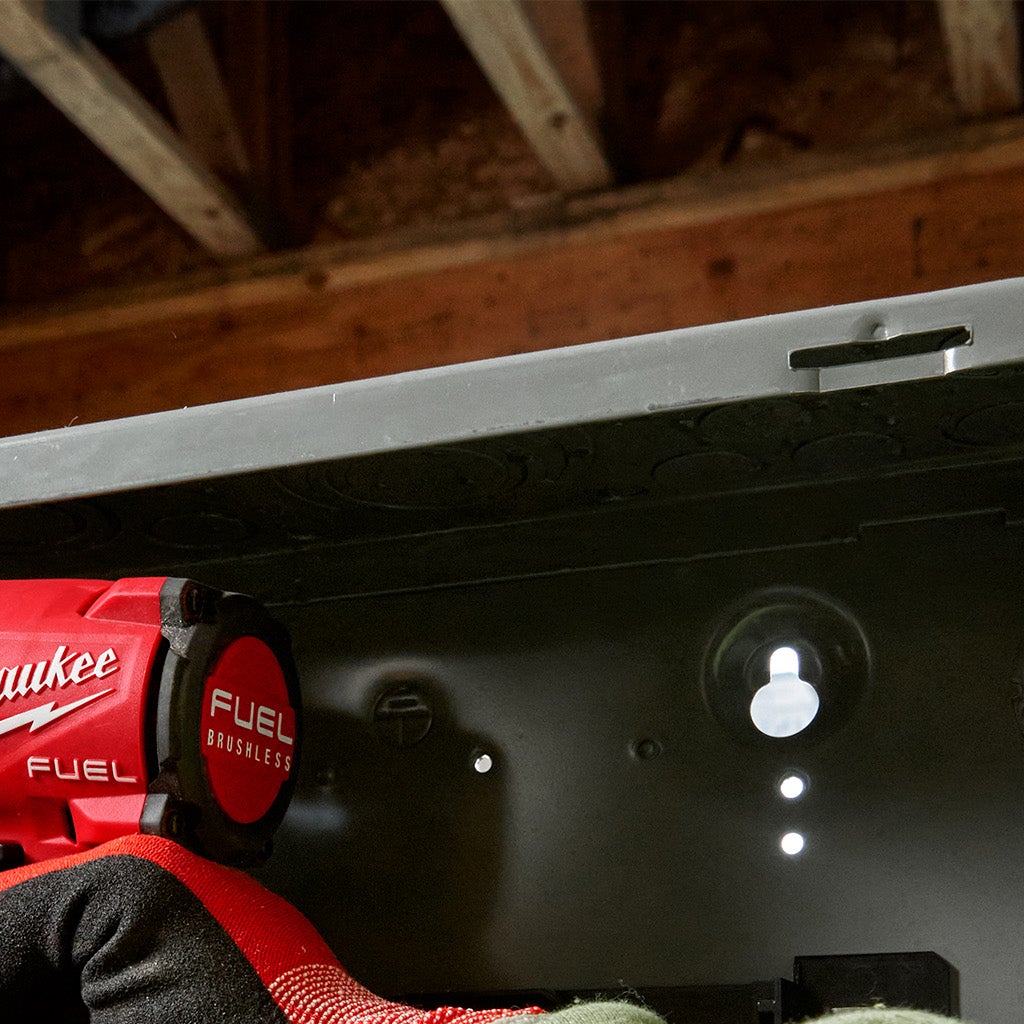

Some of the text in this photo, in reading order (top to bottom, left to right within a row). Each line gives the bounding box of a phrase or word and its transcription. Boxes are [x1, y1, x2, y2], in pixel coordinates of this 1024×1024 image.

[210, 689, 293, 745] FUEL
[27, 756, 137, 784] FUEL
[207, 728, 292, 773] BRUSHLESS
